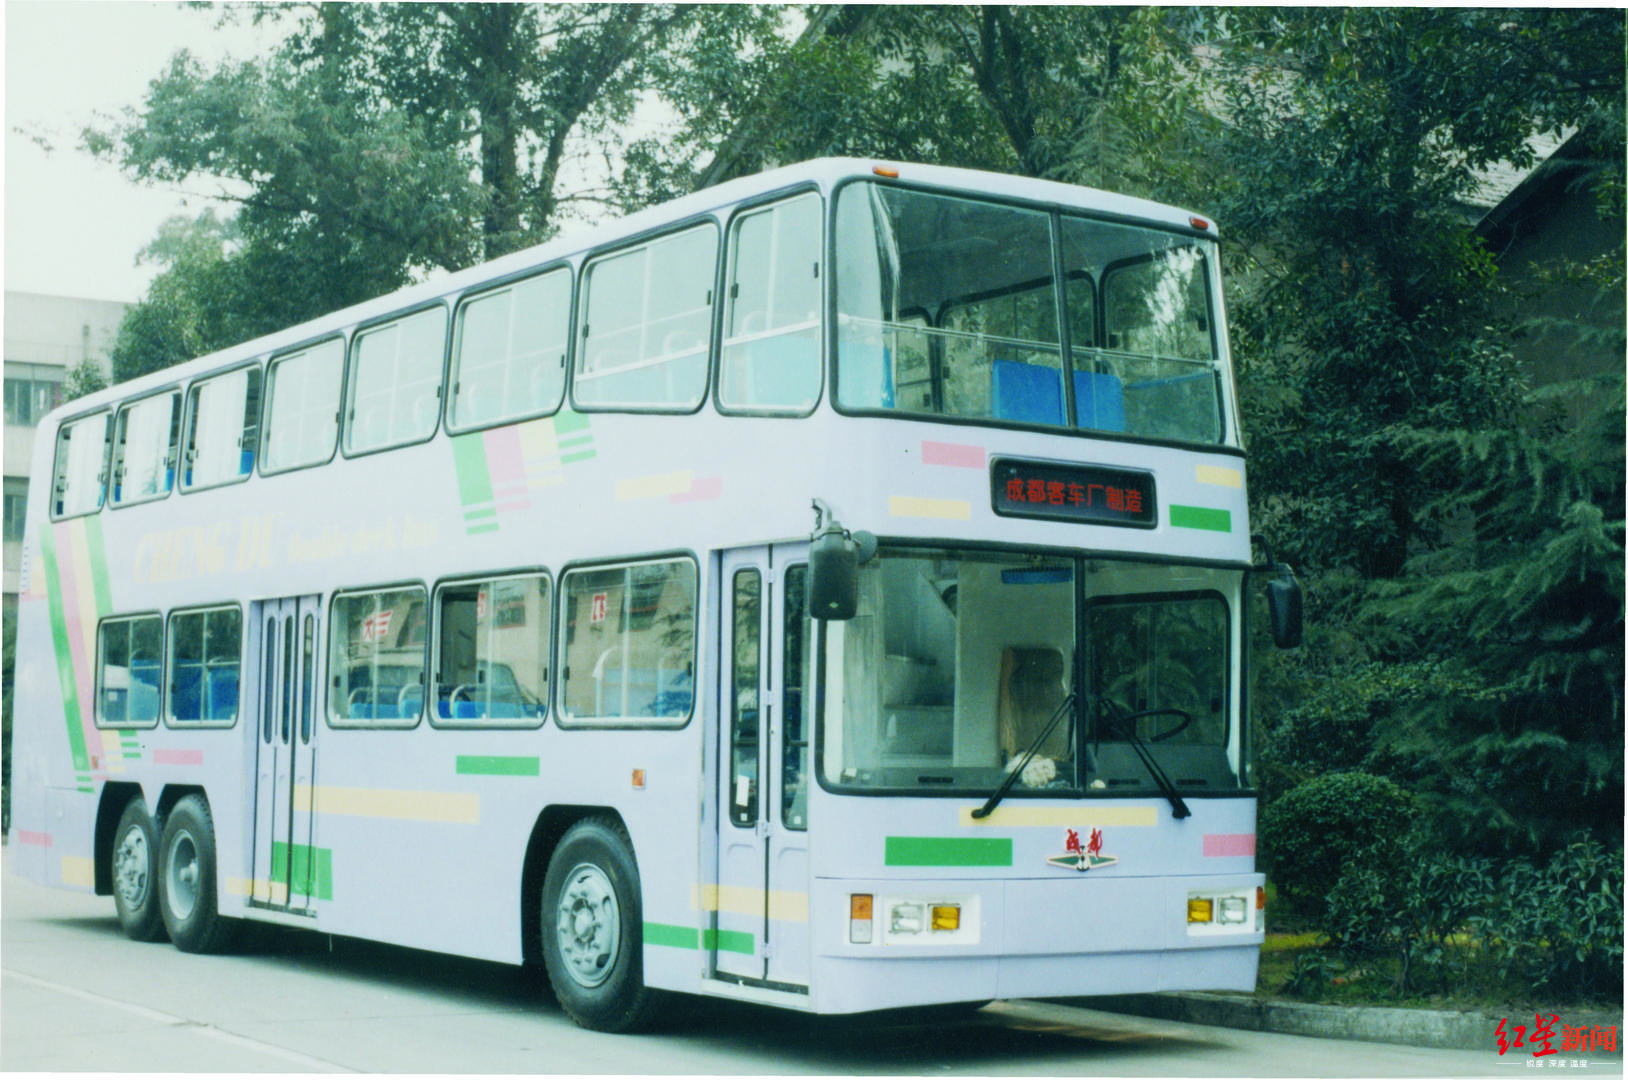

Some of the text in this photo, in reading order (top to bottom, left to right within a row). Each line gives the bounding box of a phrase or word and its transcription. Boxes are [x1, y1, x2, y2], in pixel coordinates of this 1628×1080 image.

[1007, 478, 1143, 513] 成都客车厂制造
[135, 521, 231, 584] CHENG
